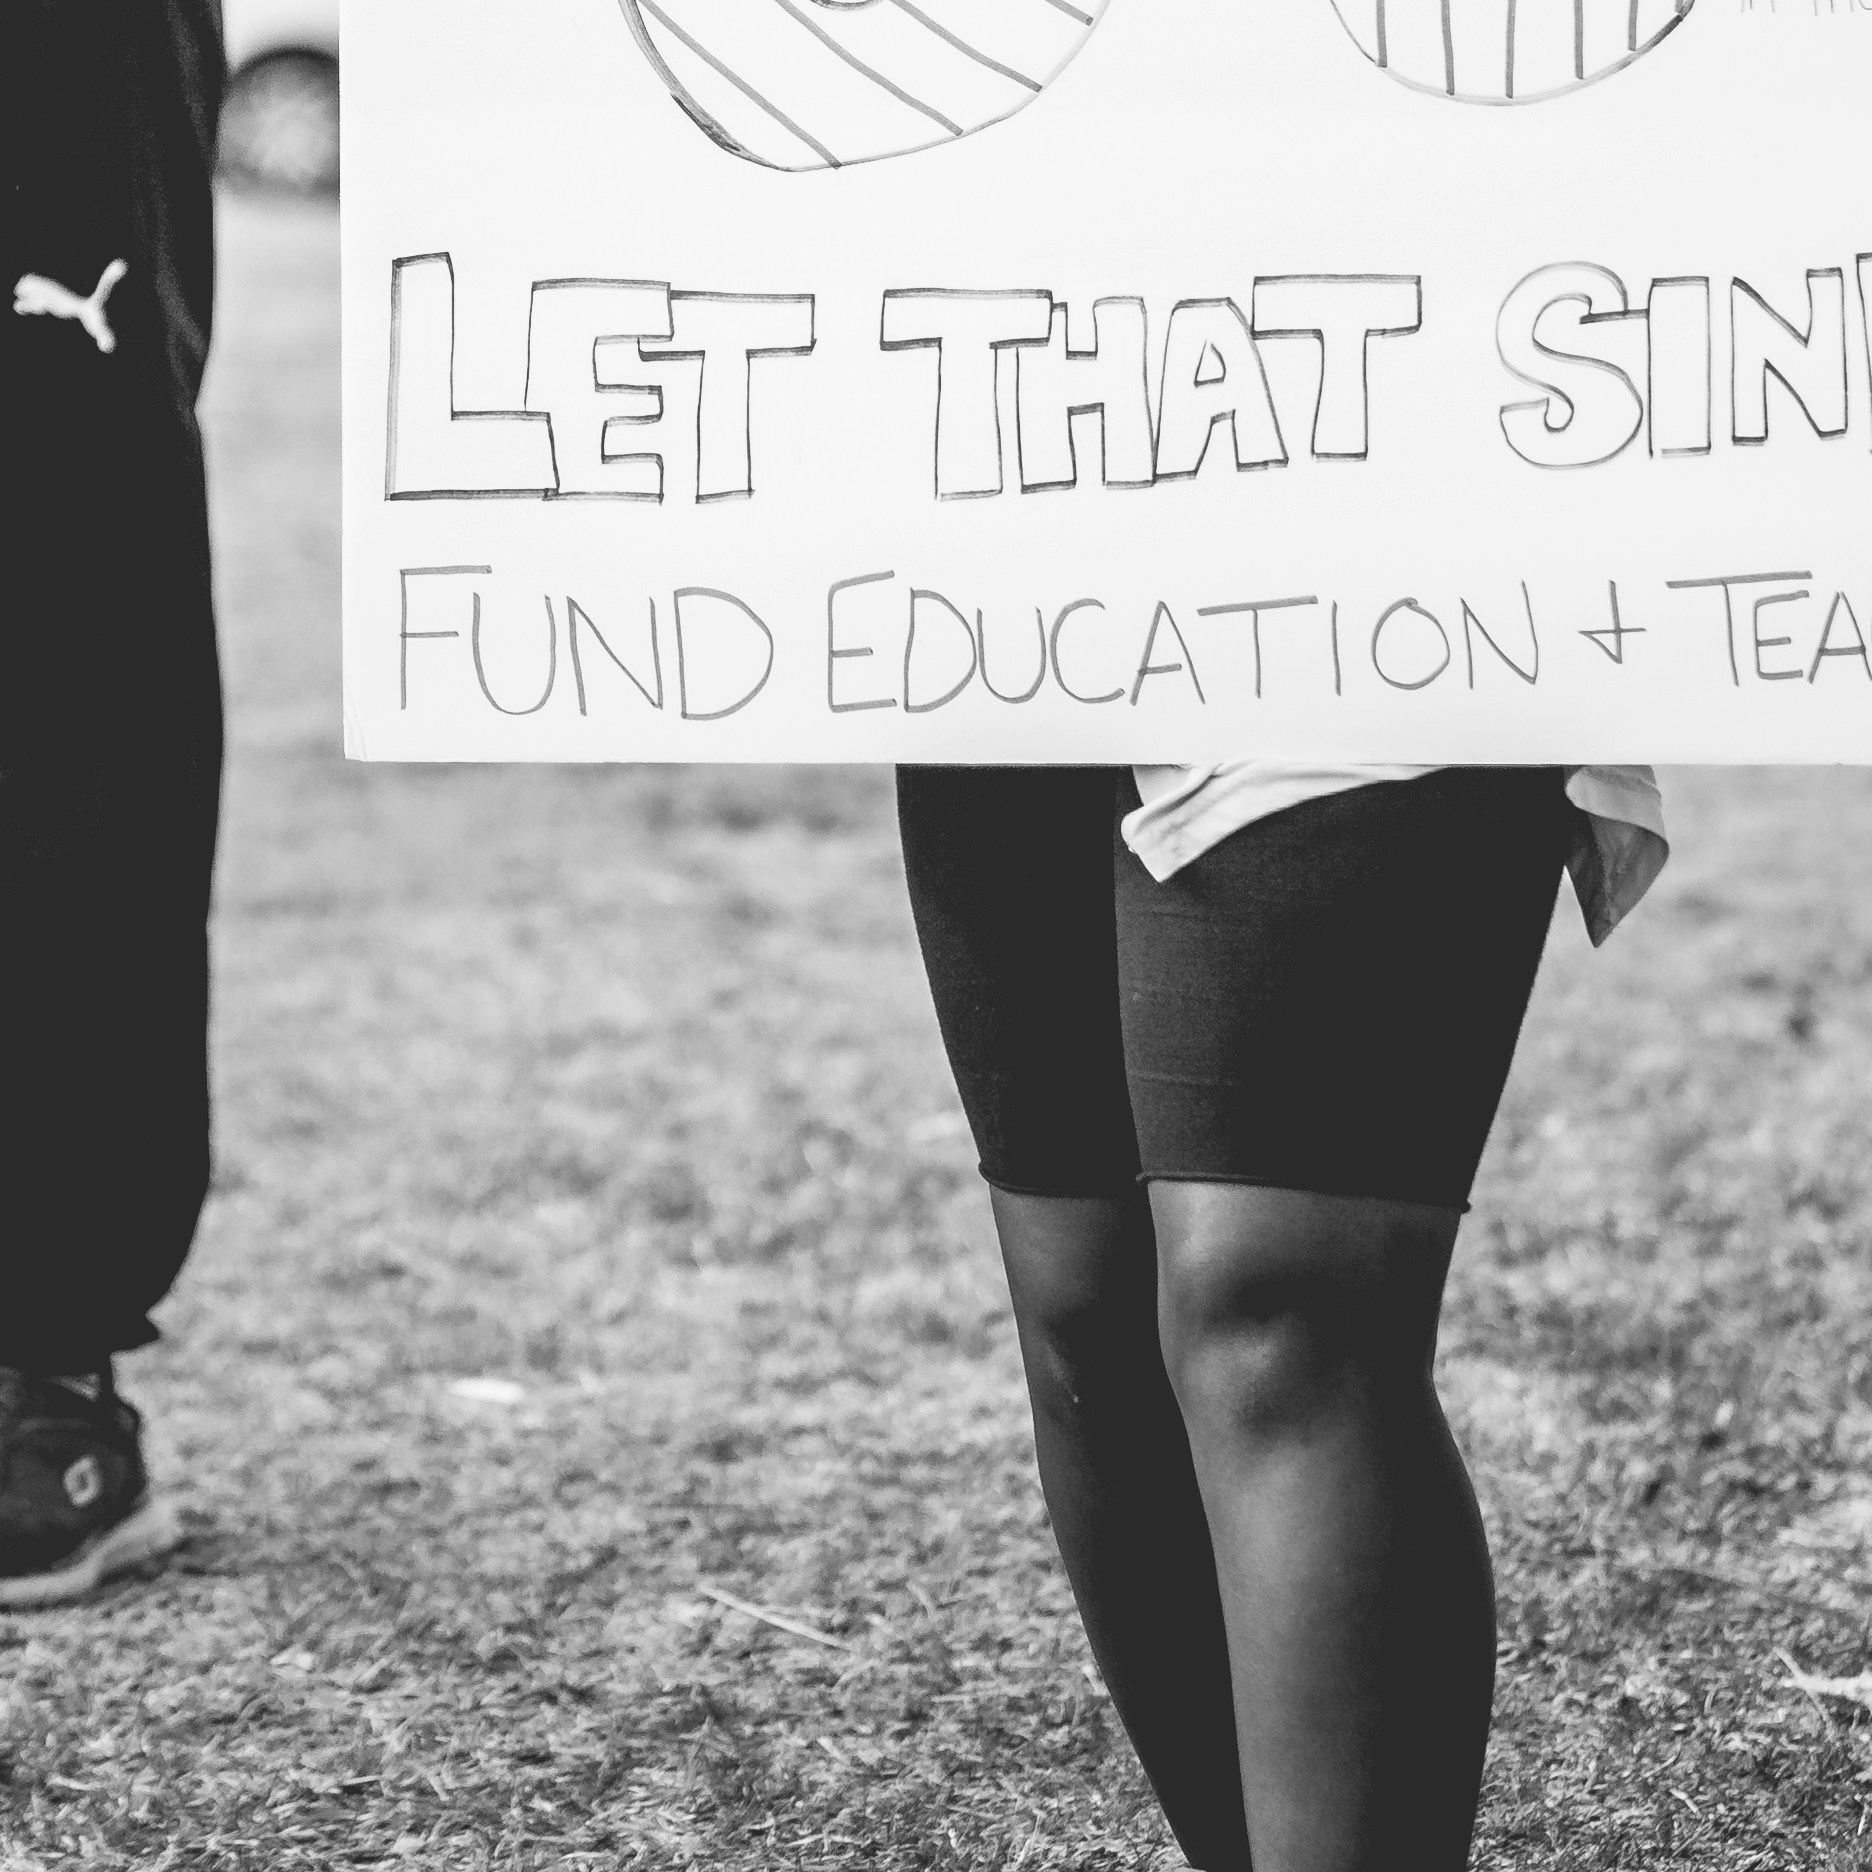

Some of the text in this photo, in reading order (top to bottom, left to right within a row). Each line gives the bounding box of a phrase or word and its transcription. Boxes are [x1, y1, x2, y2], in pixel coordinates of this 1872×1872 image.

[383, 248, 819, 507] LET
[878, 271, 1424, 503] THAT
[396, 563, 775, 722] FUND
[826, 568, 1540, 720] EDUCATION
